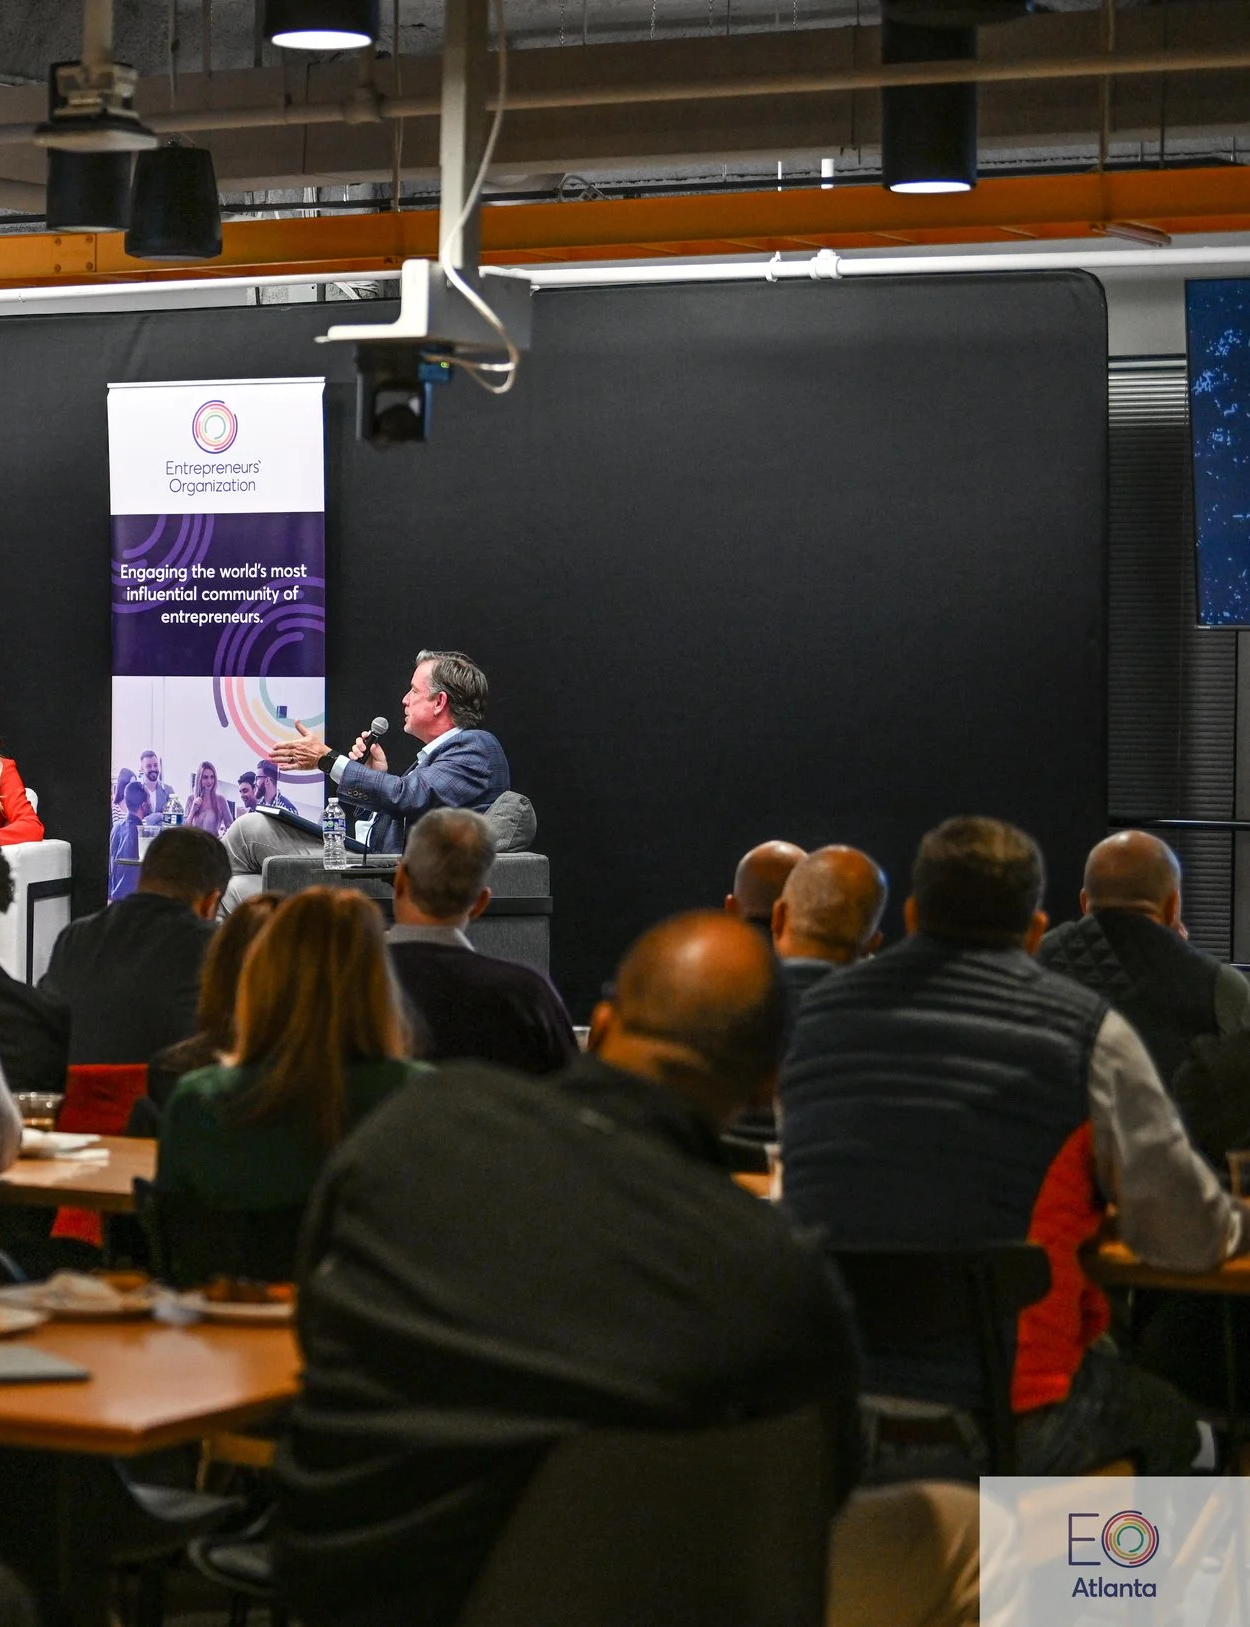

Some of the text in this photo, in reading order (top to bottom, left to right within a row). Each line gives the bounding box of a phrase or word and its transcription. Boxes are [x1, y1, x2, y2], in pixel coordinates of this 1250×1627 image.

[169, 478, 256, 496] Organization
[120, 563, 307, 582] Engaging the world's most
[126, 585, 300, 604] influential community of
[161, 610, 264, 626] entrepreneurs.
